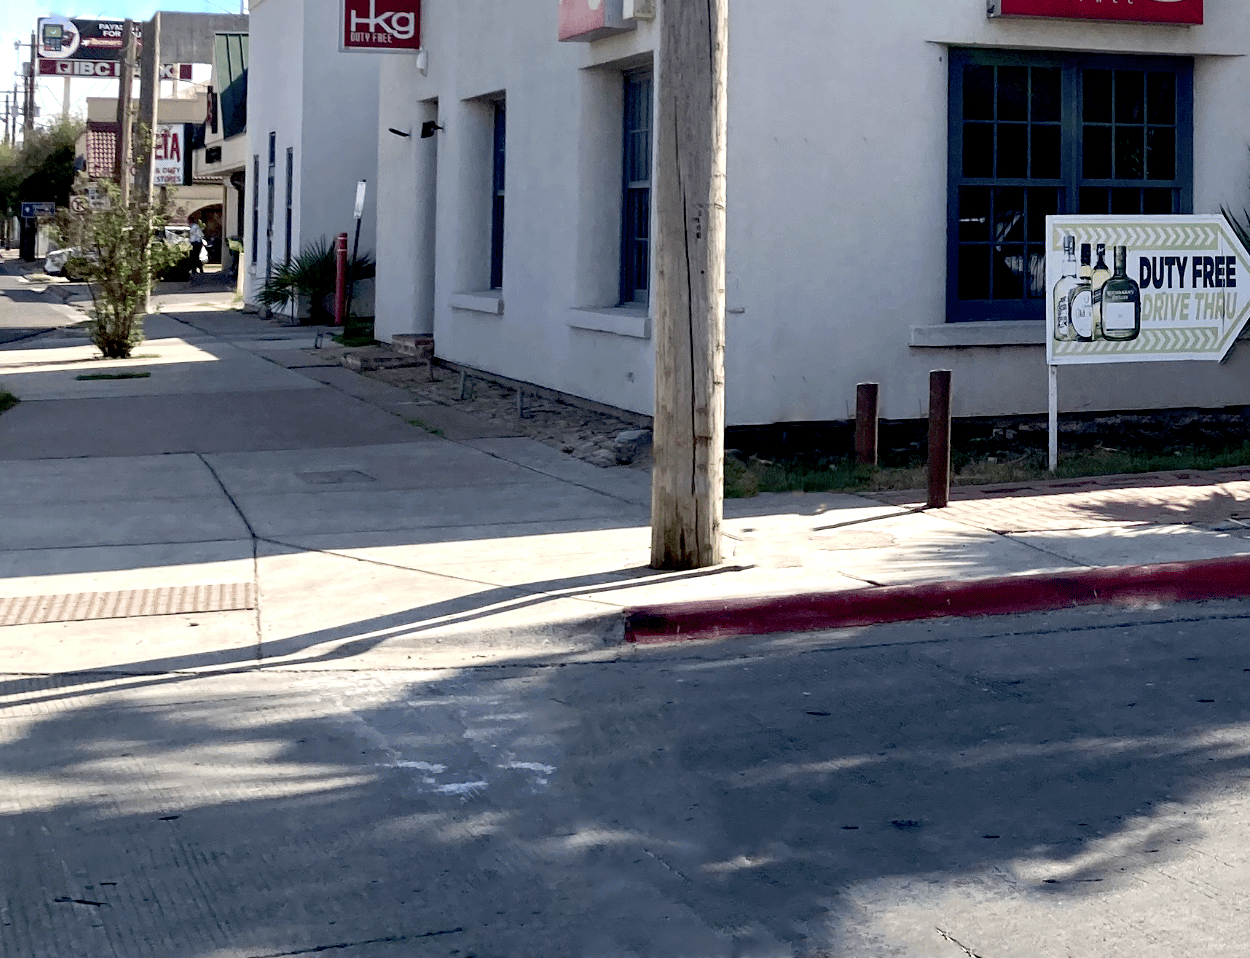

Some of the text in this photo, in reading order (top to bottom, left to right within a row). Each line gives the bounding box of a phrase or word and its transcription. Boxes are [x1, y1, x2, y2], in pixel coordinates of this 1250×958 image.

[350, 32, 393, 43] DUTY FREE
[74, 62, 111, 76] IBC
[154, 133, 181, 162] ETA
[1139, 255, 1237, 289] DUTY FREE
[1141, 292, 1238, 322] DRIVE THRU
